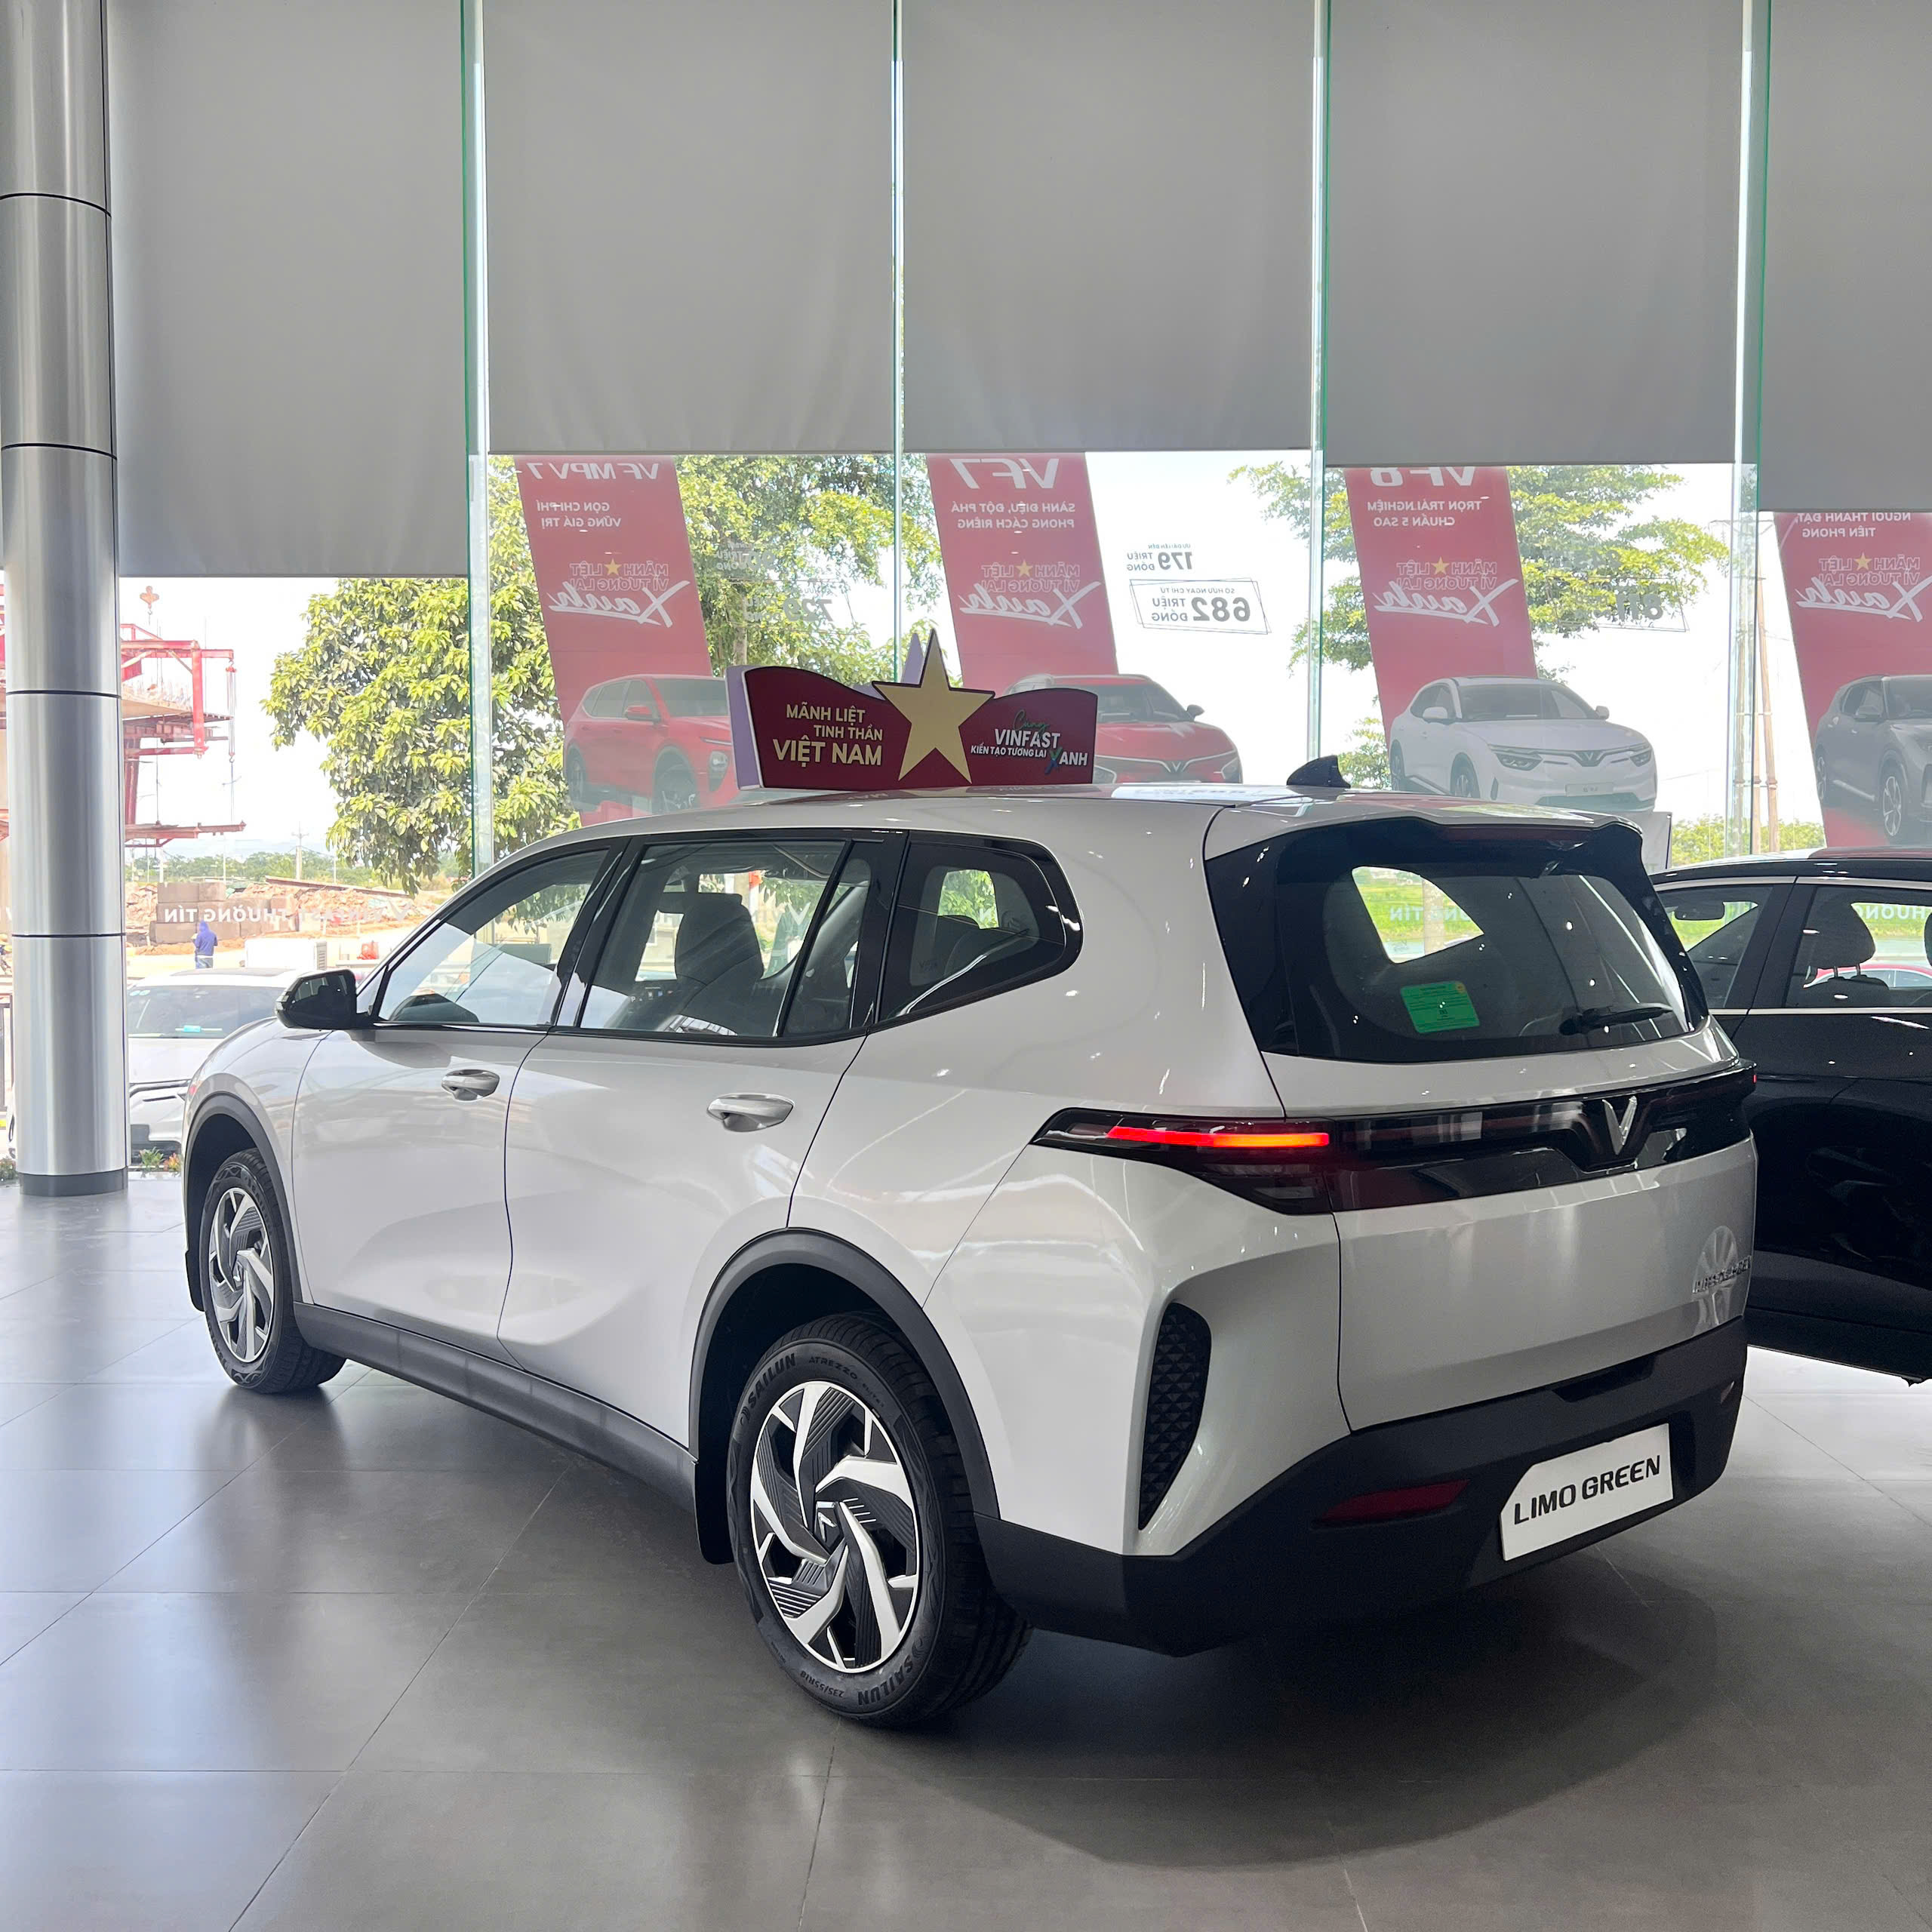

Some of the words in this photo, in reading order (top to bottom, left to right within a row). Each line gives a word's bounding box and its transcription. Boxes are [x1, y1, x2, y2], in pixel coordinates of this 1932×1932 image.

[786, 701, 832, 721] MÃNH
[835, 705, 866, 725] LIỆT
[814, 724, 844, 740] TINH
[848, 724, 883, 741] THẦN
[995, 728, 1061, 749] VINFAST
[773, 734, 826, 768] VIỆT
[832, 743, 882, 766] NAM
[971, 742, 989, 755] KIẾN
[990, 746, 1006, 758] TẠO
[1008, 746, 1035, 758] TƯƠNG
[1035, 749, 1047, 758] LAI
[748, 1352, 797, 1409] SAILUN
[808, 1355, 858, 1380] ATREZZO
[1514, 1484, 1577, 1526] LIMO
[1582, 1455, 1661, 1500] GREEN
[857, 1657, 913, 1706] SAILUN
